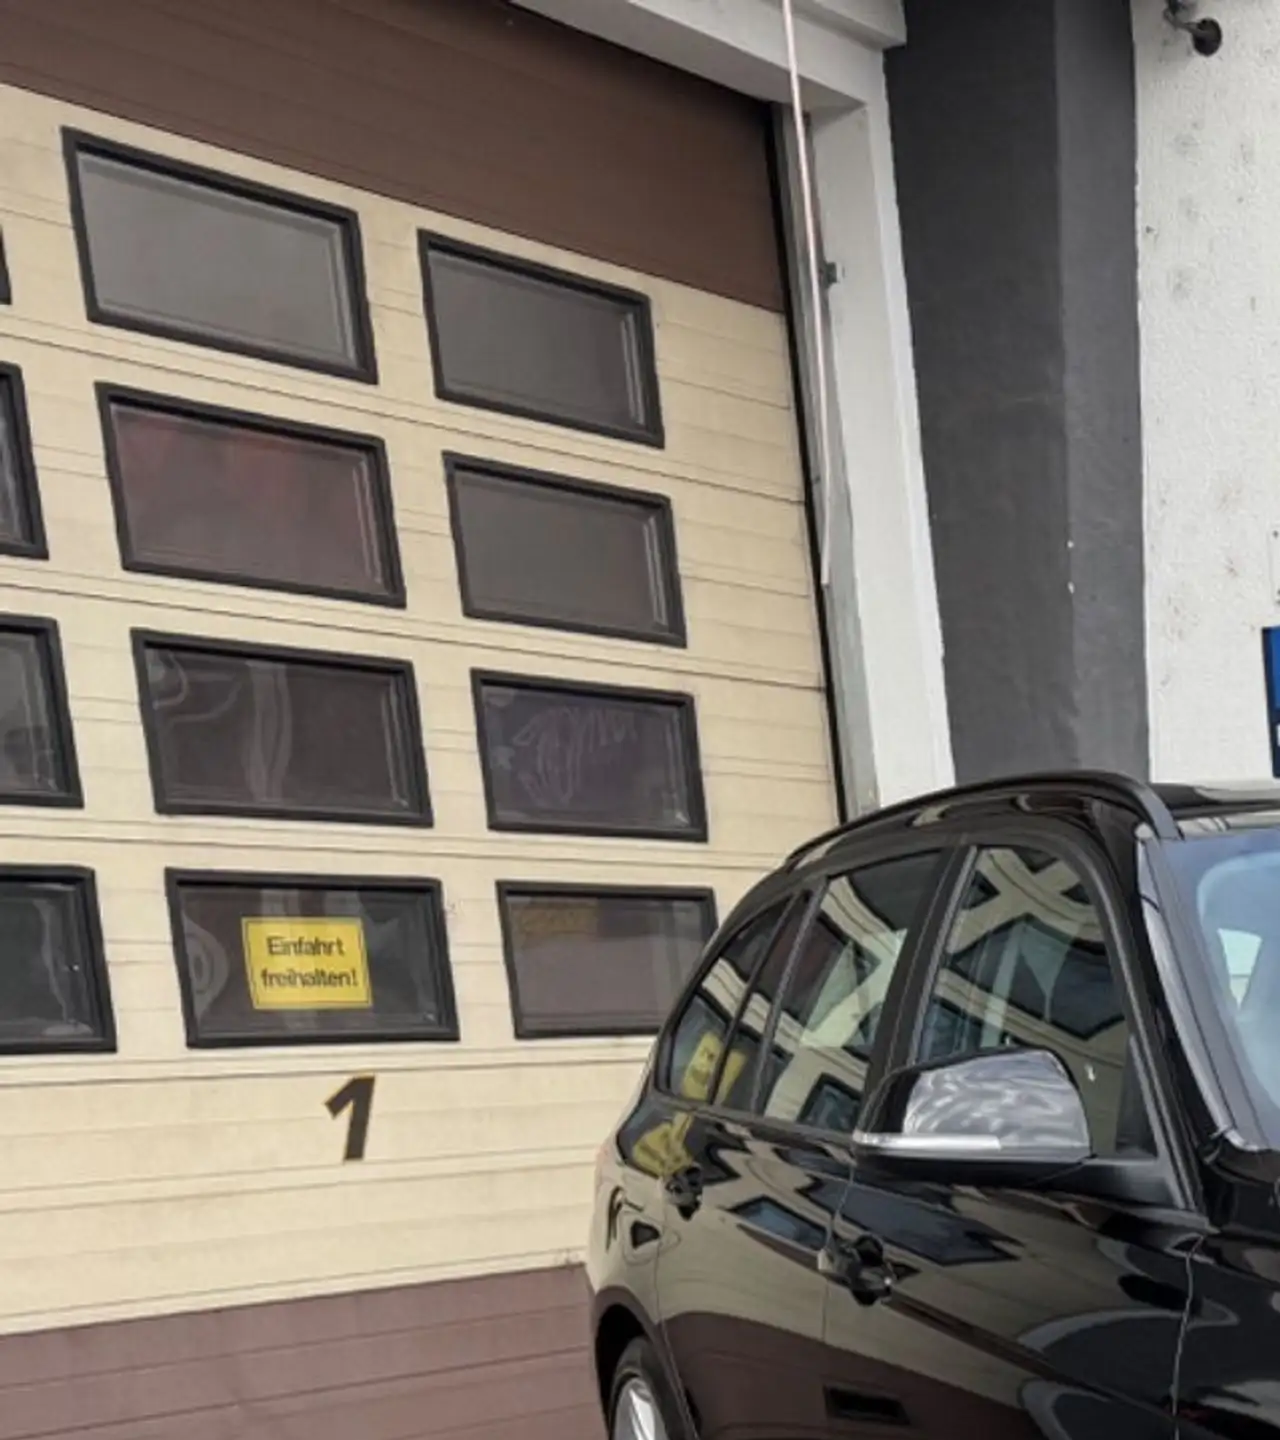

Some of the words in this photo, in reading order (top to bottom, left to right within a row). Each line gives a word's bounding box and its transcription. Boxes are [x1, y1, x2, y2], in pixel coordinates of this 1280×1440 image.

[266, 935, 346, 957] Einfahrt
[260, 968, 358, 989] freihalten!
[324, 1073, 376, 1162] 1
